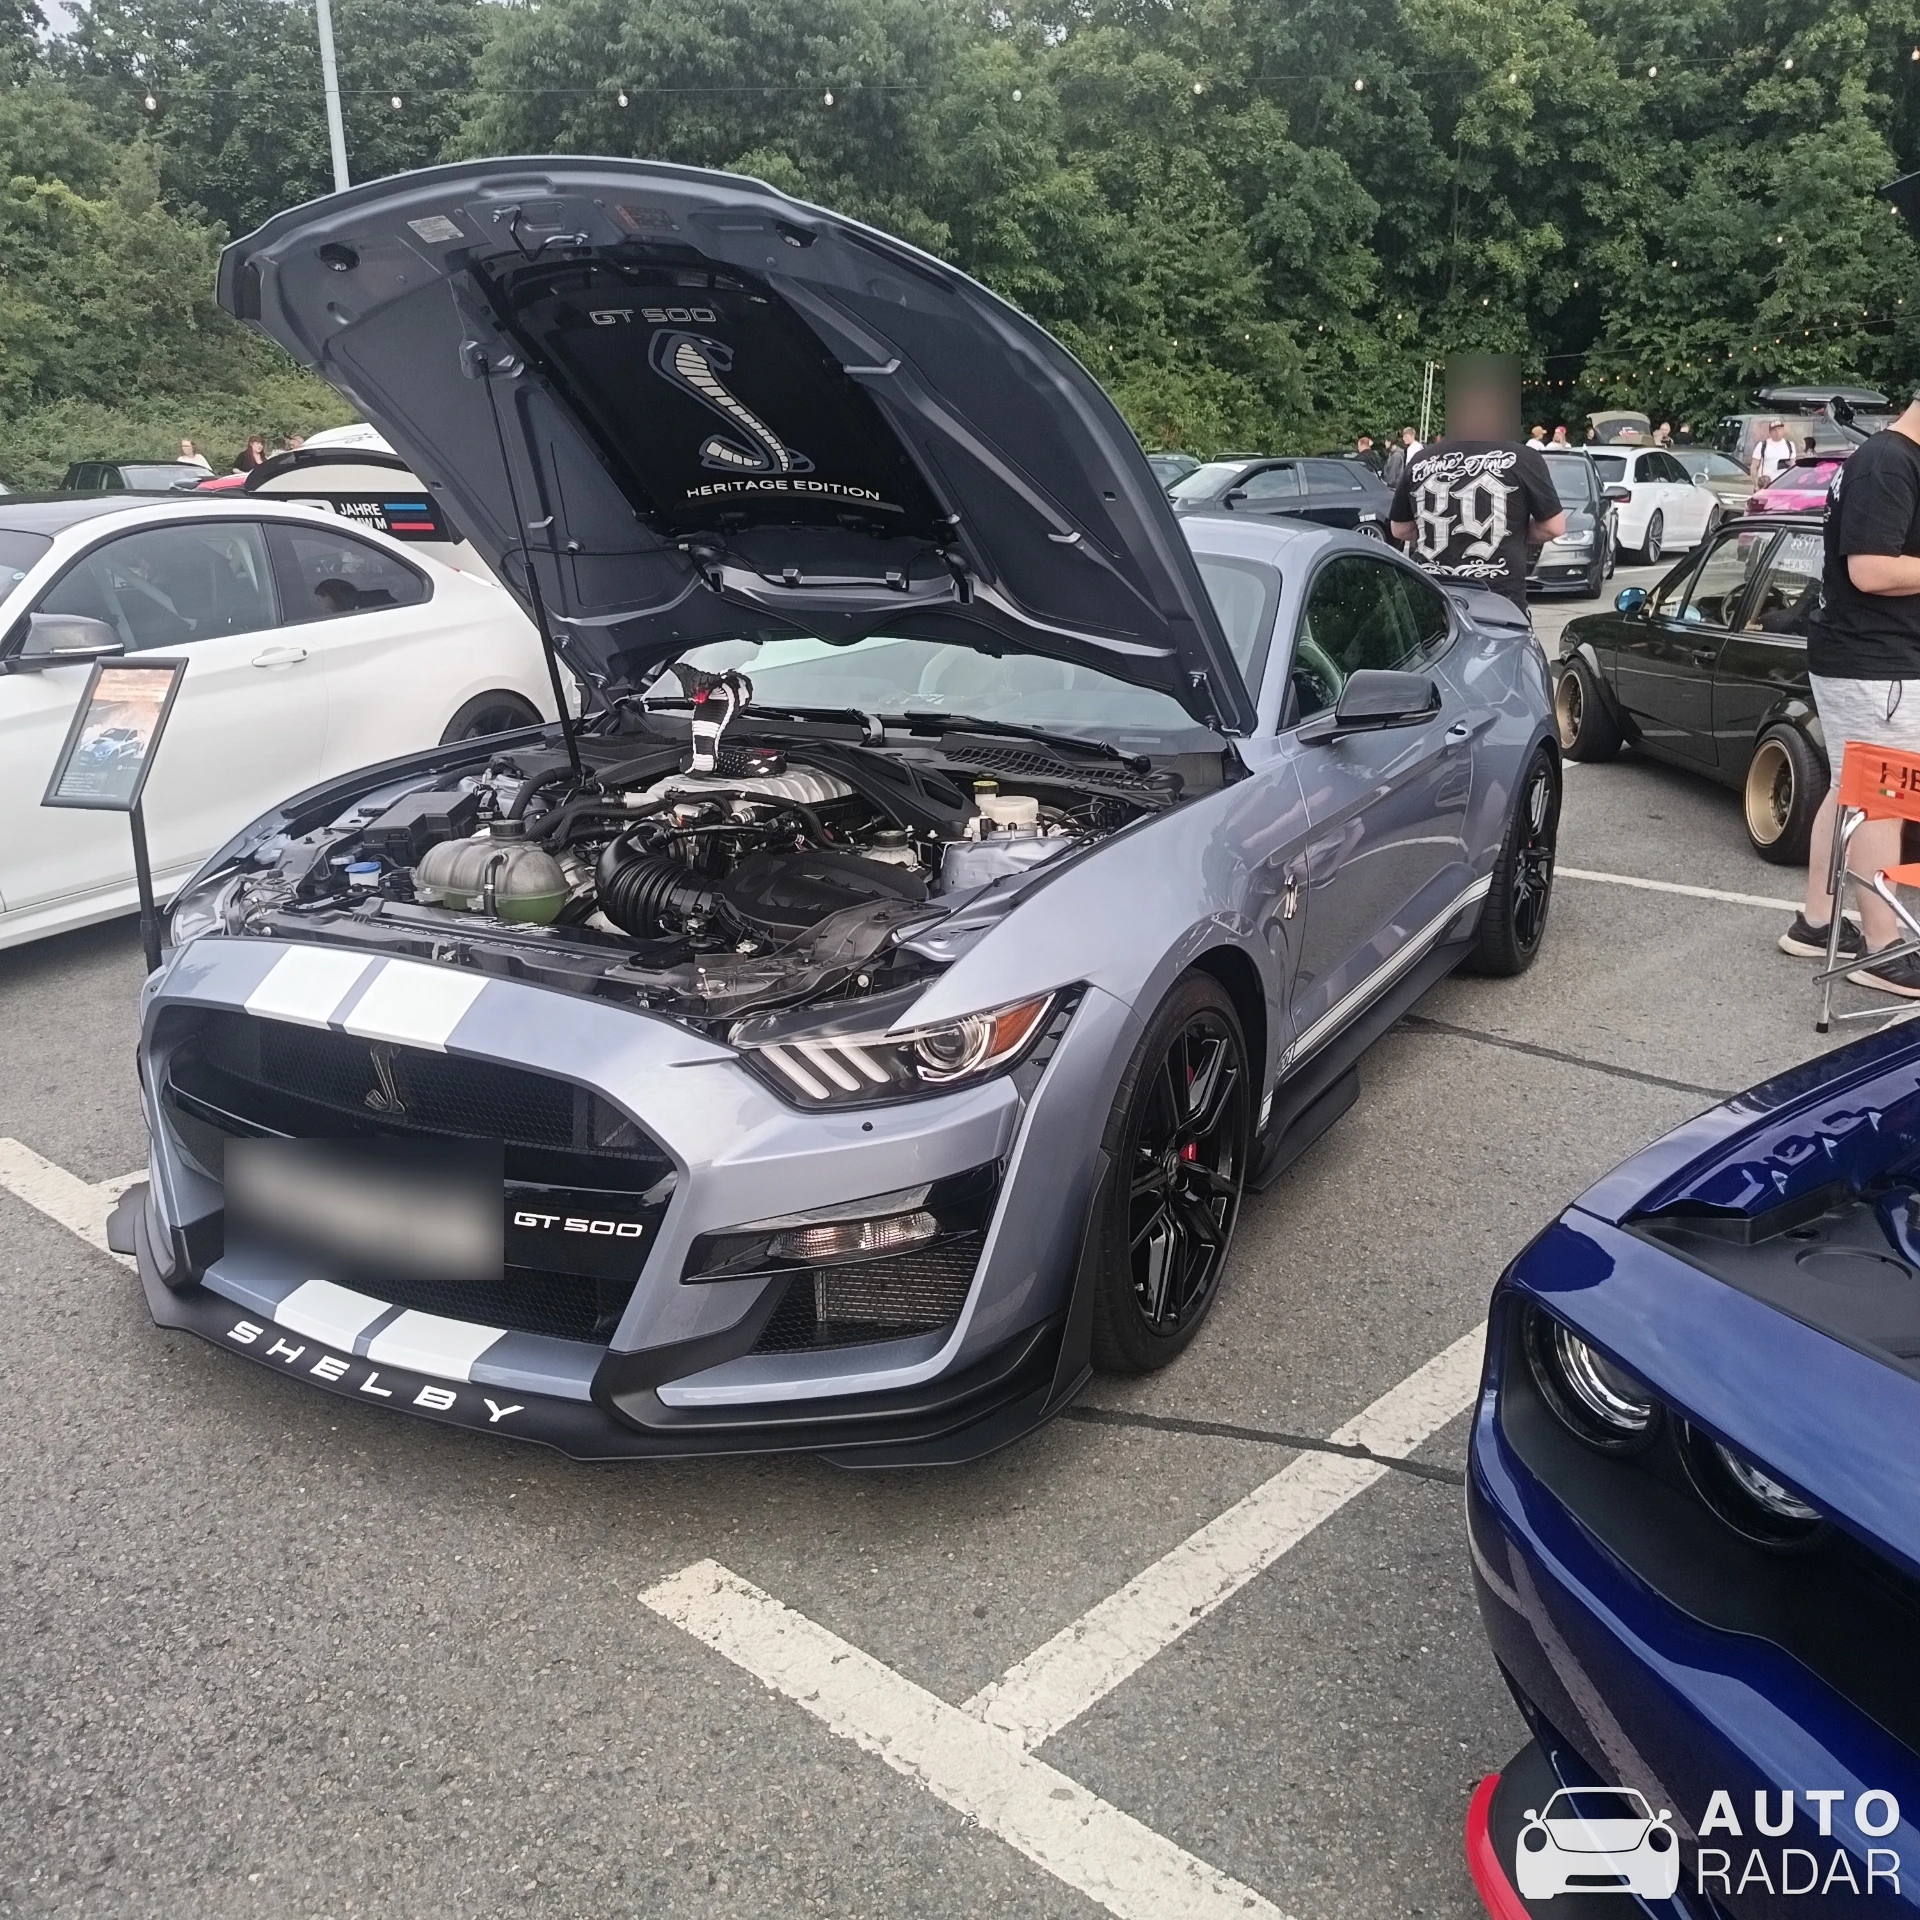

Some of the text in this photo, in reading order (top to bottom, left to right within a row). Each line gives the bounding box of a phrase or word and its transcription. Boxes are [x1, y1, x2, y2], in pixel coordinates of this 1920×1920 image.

[589, 308, 717, 325] GT 500
[686, 480, 880, 500] HERITAGE EDITION
[340, 503, 382, 516] JAHRE
[374, 517, 388, 529] M
[514, 1211, 643, 1237] GT 500
[226, 1320, 525, 1423] SHELBY
